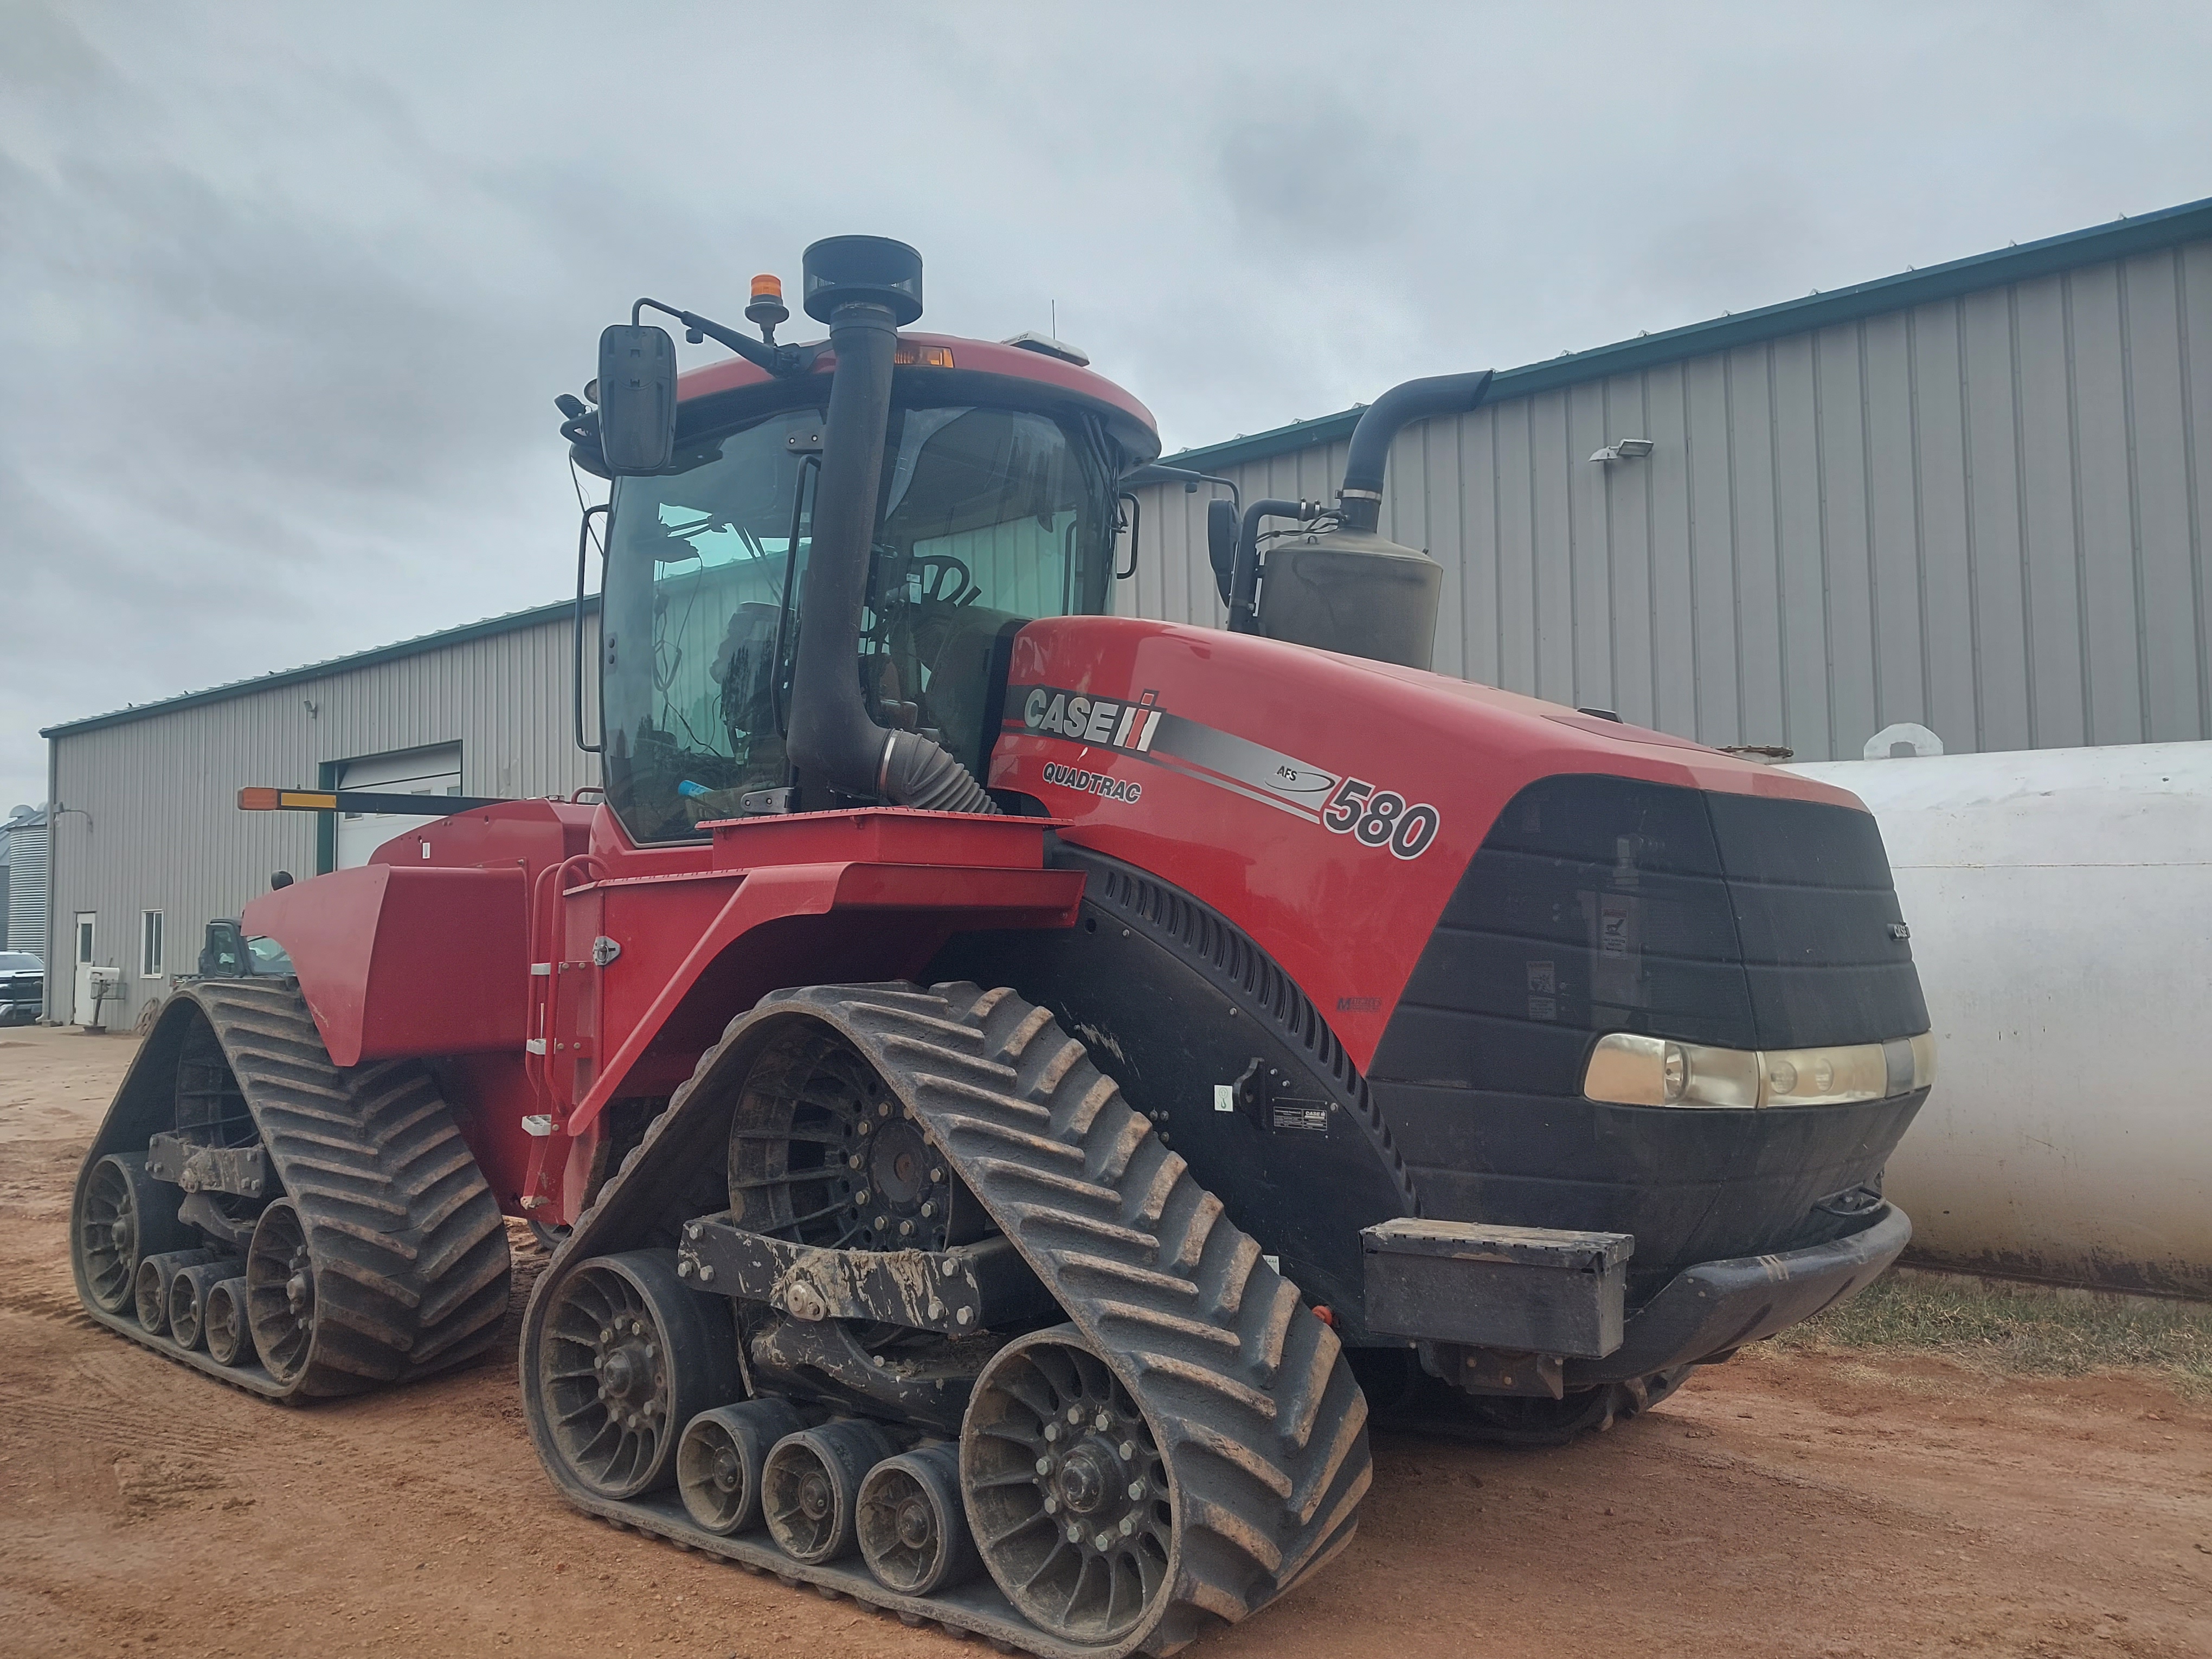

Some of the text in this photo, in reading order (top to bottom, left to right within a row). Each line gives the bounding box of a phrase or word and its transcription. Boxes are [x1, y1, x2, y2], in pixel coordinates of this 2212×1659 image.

[1043, 761, 1142, 804] QUADTRAC
[1276, 766, 1298, 781] AFS
[1323, 776, 1440, 860] 580
